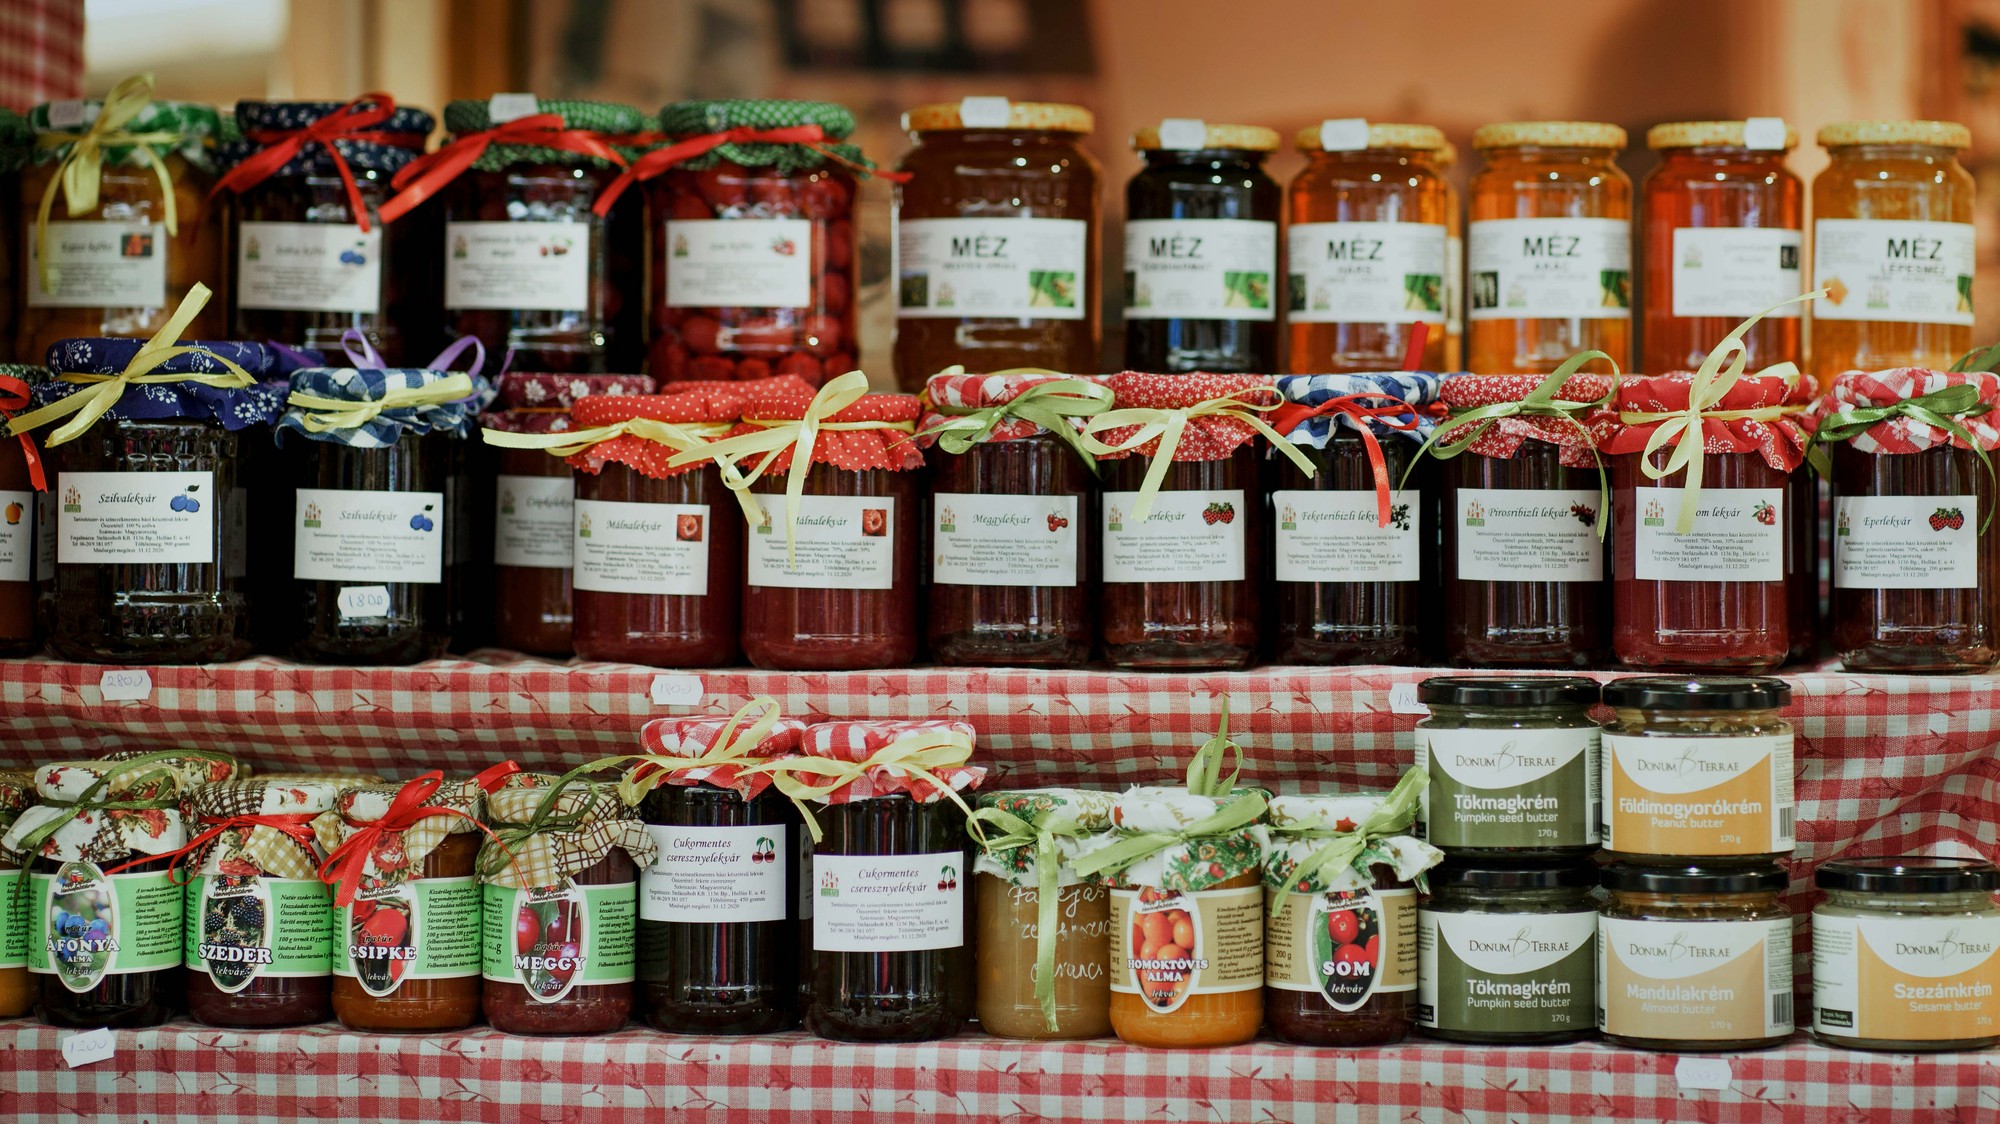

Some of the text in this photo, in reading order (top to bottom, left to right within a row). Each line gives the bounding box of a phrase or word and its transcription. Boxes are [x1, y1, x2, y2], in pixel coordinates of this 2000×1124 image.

[952, 231, 1009, 258] MÉZ
[1150, 231, 1203, 259] MÉZ
[1327, 233, 1383, 261] MÉZ
[1523, 231, 1581, 257] MÉZ
[1887, 233, 1943, 260] MÉZ
[98, 492, 157, 505] Szilvalekvár
[339, 510, 398, 523] Szilvalekvár
[1301, 510, 1356, 522] Feketeribizli
[1488, 507, 1569, 520] Pirosribizli lekvár
[1712, 506, 1741, 519] lekvár
[606, 519, 662, 532] Málnalekvár
[973, 513, 1031, 527] Meggylekvár
[1863, 515, 1912, 529] Eperlekvár
[1516, 755, 1556, 767] TERRAE
[1699, 760, 1740, 772] TERRAE
[1454, 794, 1558, 814] Tökmagkrém
[1619, 797, 1762, 820] Földimogyorókrém
[1454, 812, 1559, 825] Pumpkin seed butter
[1651, 817, 1725, 828] Peanut butter
[1538, 829, 1551, 837] 170
[673, 837, 731, 850] Cukormentes
[666, 852, 741, 865] cseresznyelekvár
[858, 867, 919, 880] Cukormentes
[850, 882, 928, 896] cseresznyelekvár
[45, 934, 121, 953] ÁFONYA
[1531, 941, 1569, 951] TERRAE
[1959, 943, 1991, 953] TERRAE
[198, 943, 273, 964] SZEDER
[348, 945, 417, 960] CSIPKE
[1276, 950, 1287, 959] 200
[1689, 946, 1730, 958] TERRAE
[67, 955, 93, 963] ALMA
[514, 955, 586, 971] MEGGY
[1127, 959, 1209, 970] HOMOKTÖVIS
[1322, 961, 1371, 977] SOM
[1147, 972, 1184, 982] ALMA
[1331, 984, 1363, 993] lekvár
[1467, 979, 1570, 999] Tökmagkrém
[1627, 983, 1734, 1000] Mandulakrém
[1894, 981, 1992, 999] Szezámkrém
[1467, 997, 1571, 1010] Pumpkin seed butter
[1641, 1002, 1717, 1014] Almond butter
[1909, 1000, 1983, 1012] Sesame butter
[1552, 1014, 1564, 1022] 170
